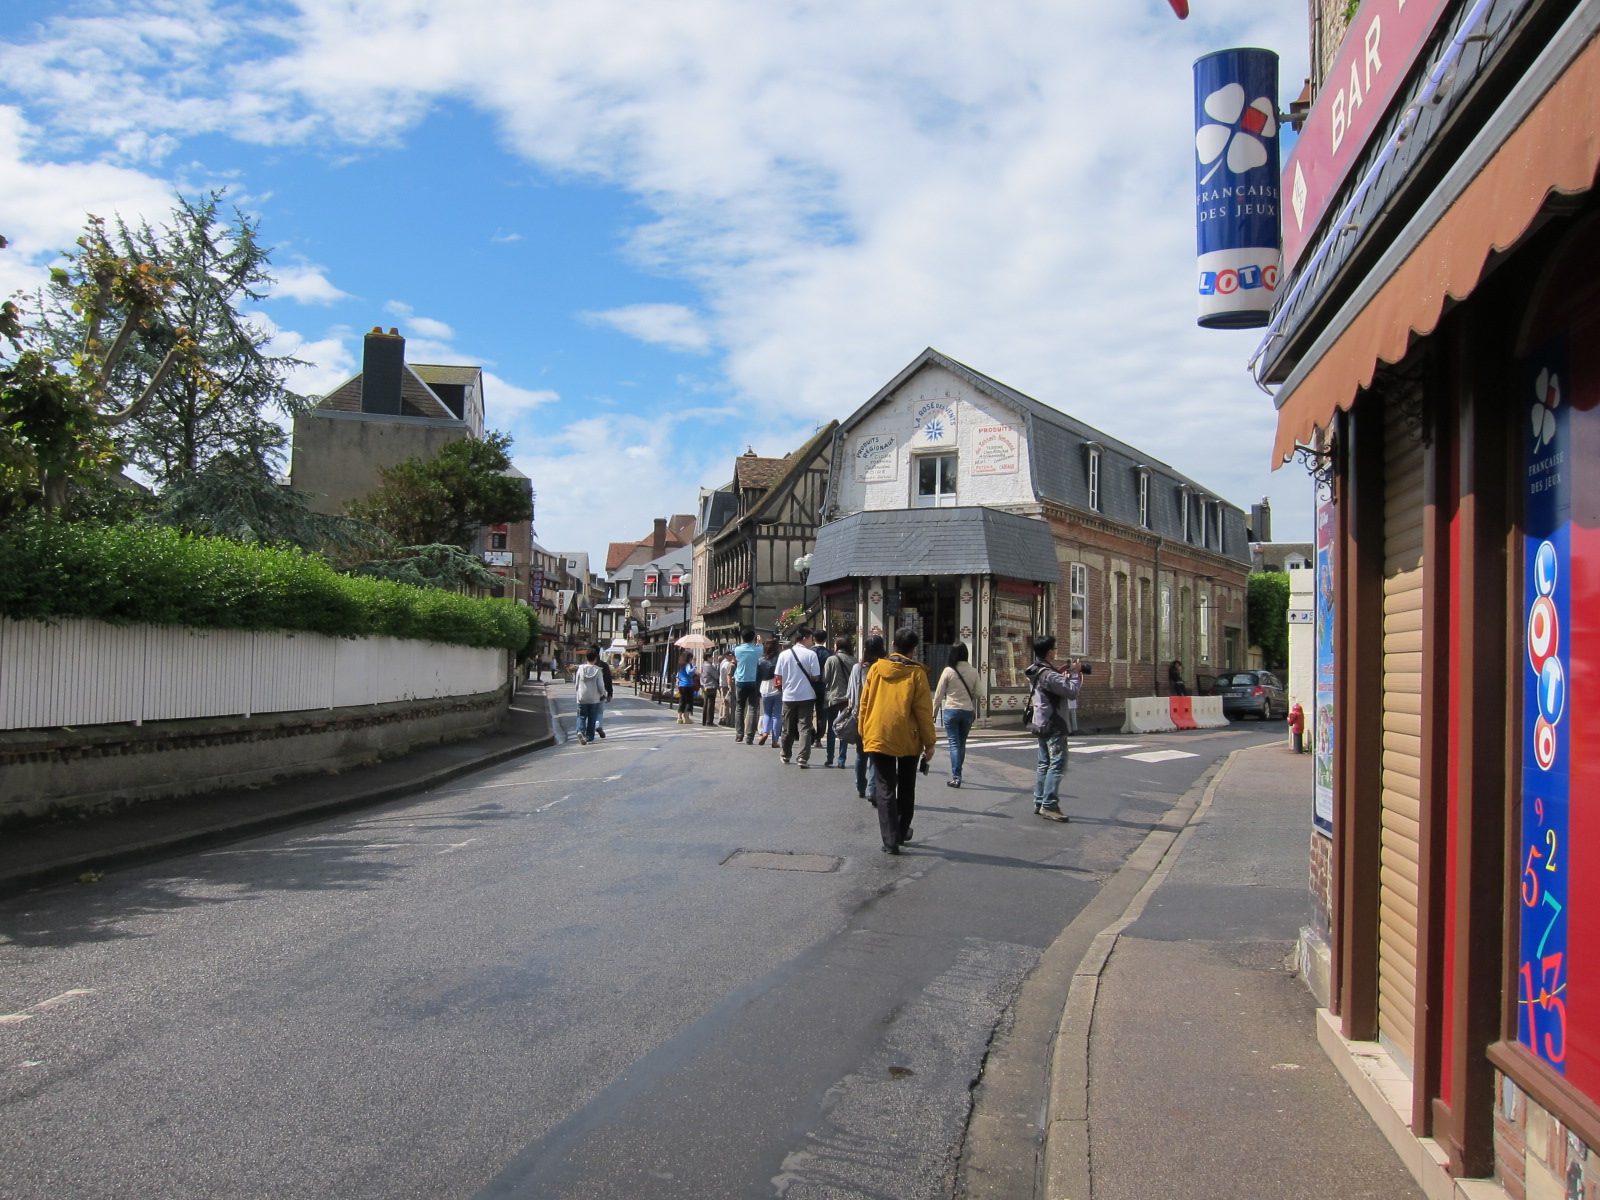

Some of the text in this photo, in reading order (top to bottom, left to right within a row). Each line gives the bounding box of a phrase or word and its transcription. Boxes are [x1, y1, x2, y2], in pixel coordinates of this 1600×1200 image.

[1331, 14, 1383, 157] BAR
[1200, 204, 1275, 222] DES JEUX
[918, 402, 935, 417] ROSE
[945, 405, 957, 426] VENTS
[978, 425, 1013, 434] PRODUITS
[856, 436, 880, 459] PRODUITS
[1530, 472, 1562, 494] DES JEUX
[1529, 545, 1564, 768] LOTO
[1535, 798, 1544, 826] 9
[1545, 829, 1557, 872] 2
[1522, 845, 1542, 907] 5
[1536, 889, 1562, 960] 7
